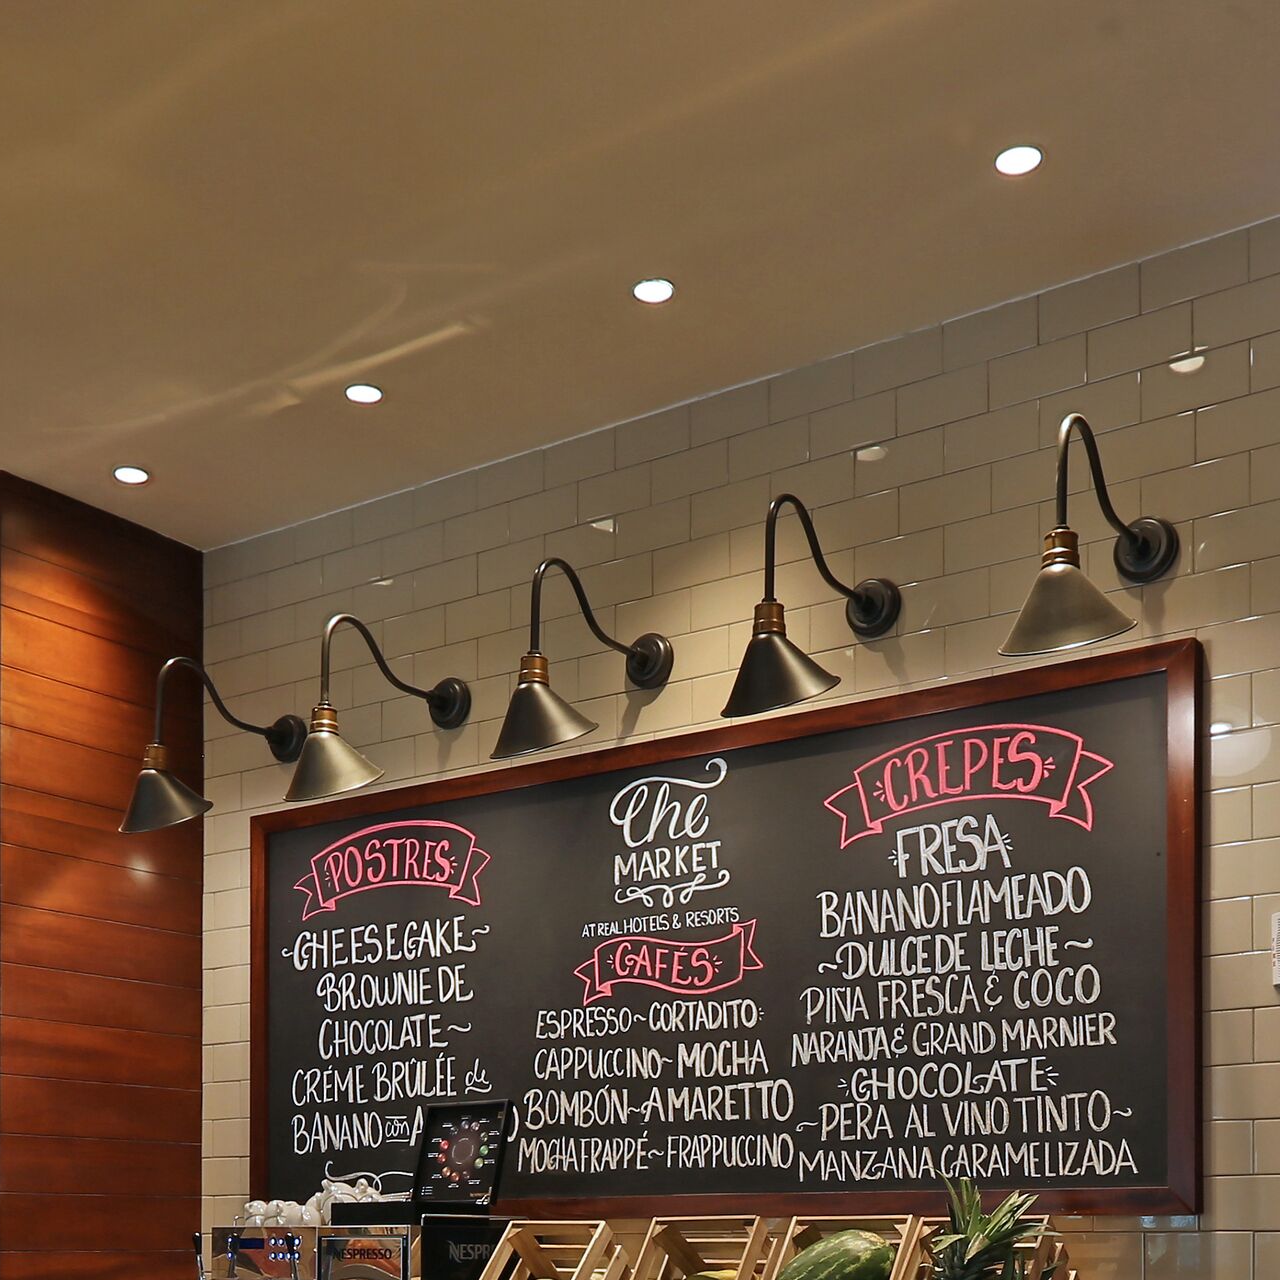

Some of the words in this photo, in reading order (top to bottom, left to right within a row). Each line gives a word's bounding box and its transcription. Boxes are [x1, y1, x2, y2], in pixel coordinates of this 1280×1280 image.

[882, 731, 1044, 812] CREPES
[324, 837, 451, 892] POSTRES
[614, 840, 722, 886] MARKET
[895, 813, 1012, 878] FRESA
[581, 923, 597, 938] AT
[597, 922, 623, 936] REAL
[623, 913, 670, 935] HOTELS
[672, 913, 682, 929] &
[685, 907, 740, 928] RESORTS
[816, 881, 941, 938] BANANO
[292, 915, 478, 972] CHEESECAKE
[614, 942, 715, 987] CAFÉS
[834, 934, 932, 980] DULCE
[934, 931, 971, 975] DE
[980, 925, 1060, 972] LECHE
[316, 966, 435, 1013] BROWNIE
[437, 963, 474, 1003] DE
[799, 986, 870, 1025] PIÑA
[877, 973, 982, 1020] FRESCA
[1013, 963, 1101, 1010] COCO
[317, 1013, 449, 1060] CHOCOLATE
[535, 1006, 632, 1039] ESPRESSO
[648, 998, 758, 1032] CORTADITO
[791, 1026, 892, 1068] NARANJA
[912, 1020, 997, 1057] GRAND
[1001, 1011, 1118, 1053] MARNIER
[371, 1052, 457, 1101] BRÛLÉE
[463, 1058, 491, 1090] de
[534, 1046, 663, 1081] CAPPUCCINO
[677, 1038, 770, 1079] MOCHA
[850, 1056, 1049, 1102] CHOCOLATE
[523, 1084, 629, 1130] BOMBÓN
[640, 1078, 794, 1123] AMARETTO
[818, 1102, 895, 1141] PERA
[905, 1103, 936, 1139] AL
[942, 1096, 1010, 1138] VINO
[1013, 1089, 1111, 1134] TINTO
[291, 1111, 383, 1155] BANANO
[384, 1117, 411, 1140] con
[517, 1136, 579, 1174] MOCHA
[579, 1130, 649, 1173] FRAPPÉ
[666, 1132, 795, 1170] FRAPPUCCINO
[798, 1145, 936, 1182] MANZANA
[940, 1138, 1139, 1179] CARAMELIZADA
[333, 1244, 392, 1262] NESPRESSO
[447, 1240, 495, 1263] NESPR
